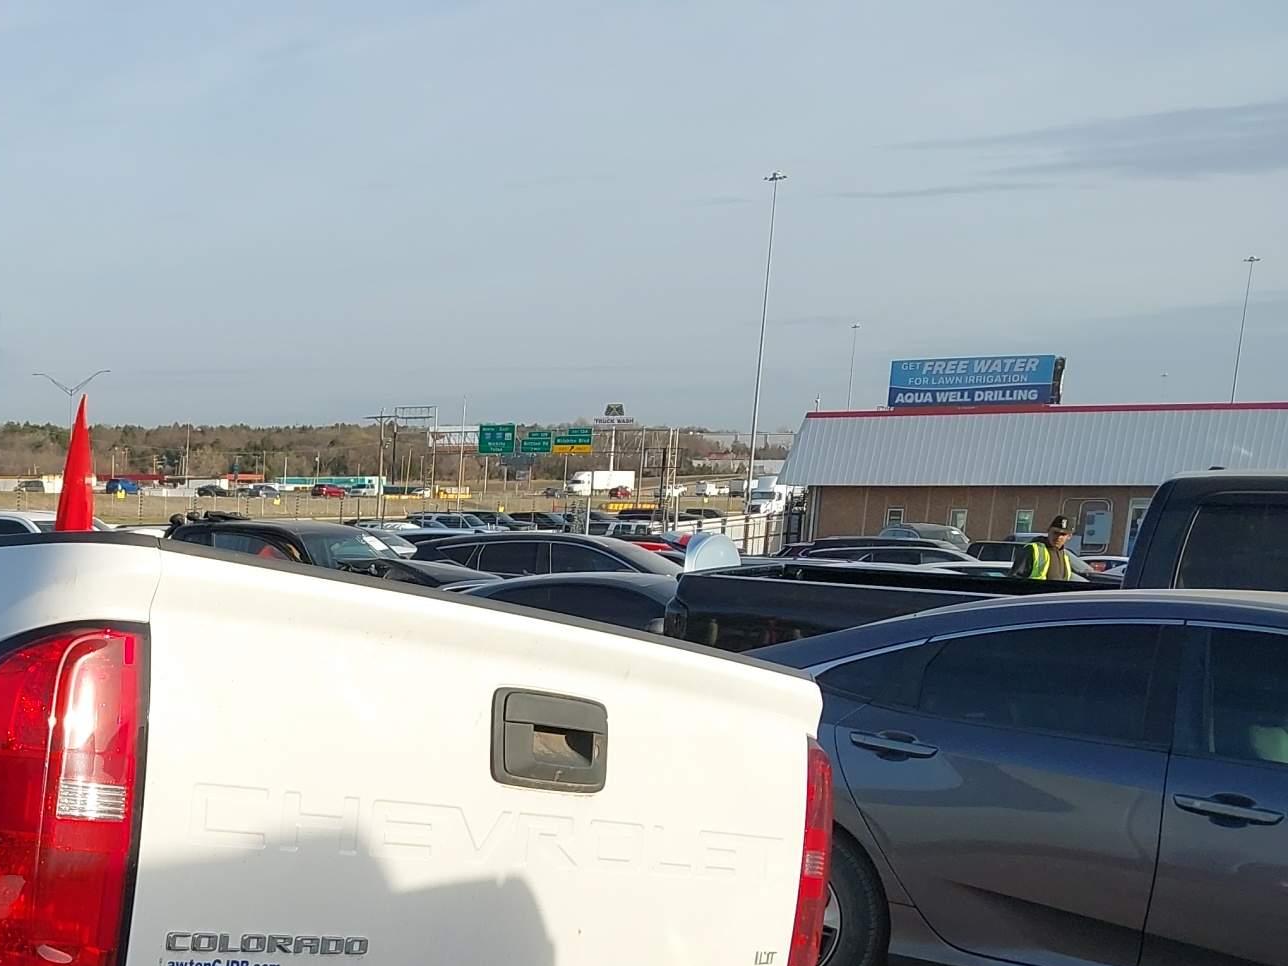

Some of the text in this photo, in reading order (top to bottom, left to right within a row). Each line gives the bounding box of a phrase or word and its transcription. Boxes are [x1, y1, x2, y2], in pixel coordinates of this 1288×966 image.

[901, 358, 1040, 375] GET FREE WATER
[908, 374, 1028, 386] FOR LAWN IRRIGATION
[894, 389, 1038, 404] AQUA WELL DRILLING
[192, 782, 784, 881] CHEVROLET
[165, 931, 370, 956] COLORADO
